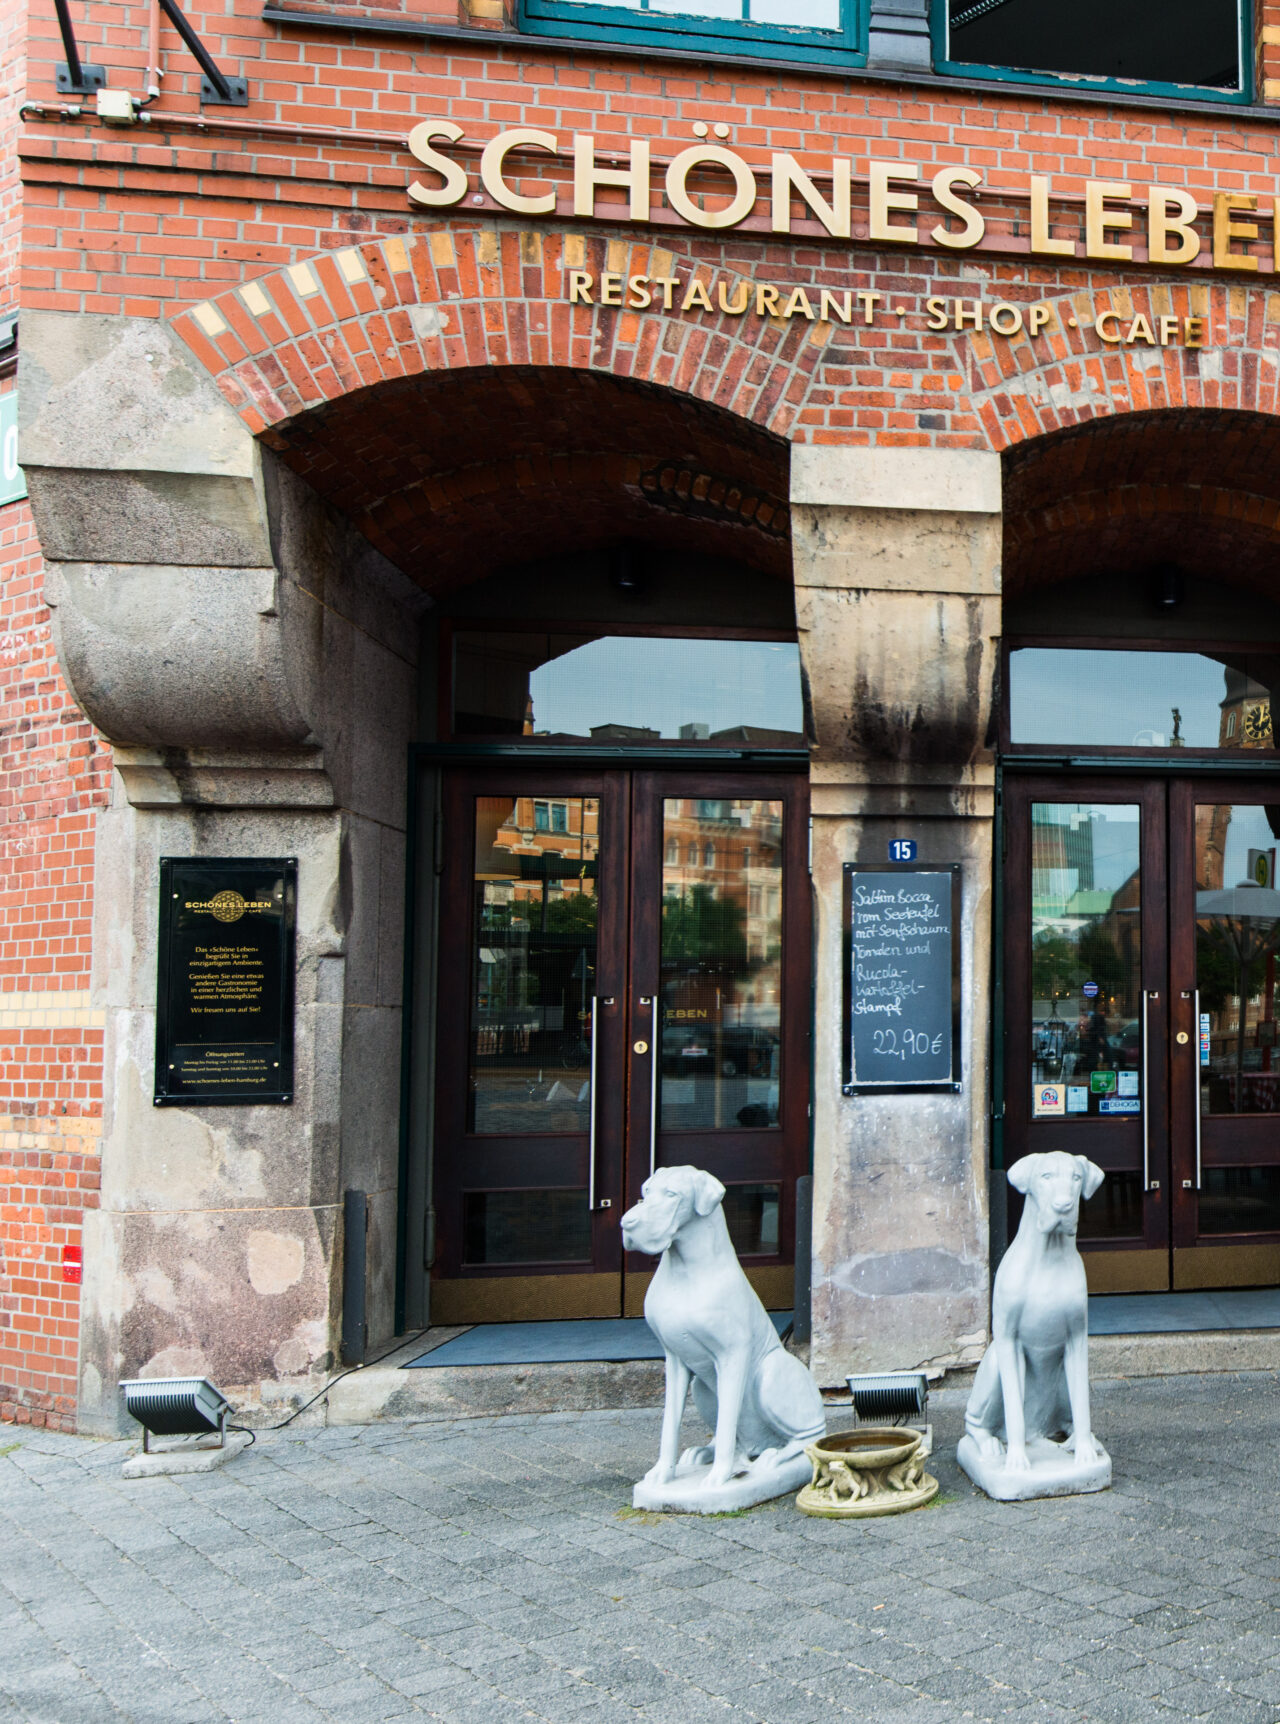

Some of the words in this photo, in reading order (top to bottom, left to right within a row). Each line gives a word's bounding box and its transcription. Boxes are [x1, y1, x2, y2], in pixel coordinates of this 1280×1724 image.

[406, 119, 986, 249] SCHÖNES
[569, 270, 881, 324] RESTAURANT
[926, 297, 1049, 336] SHOP
[894, 841, 911, 860] 15
[905, 940, 931, 955] und
[663, 1009, 707, 1019] EBEN
